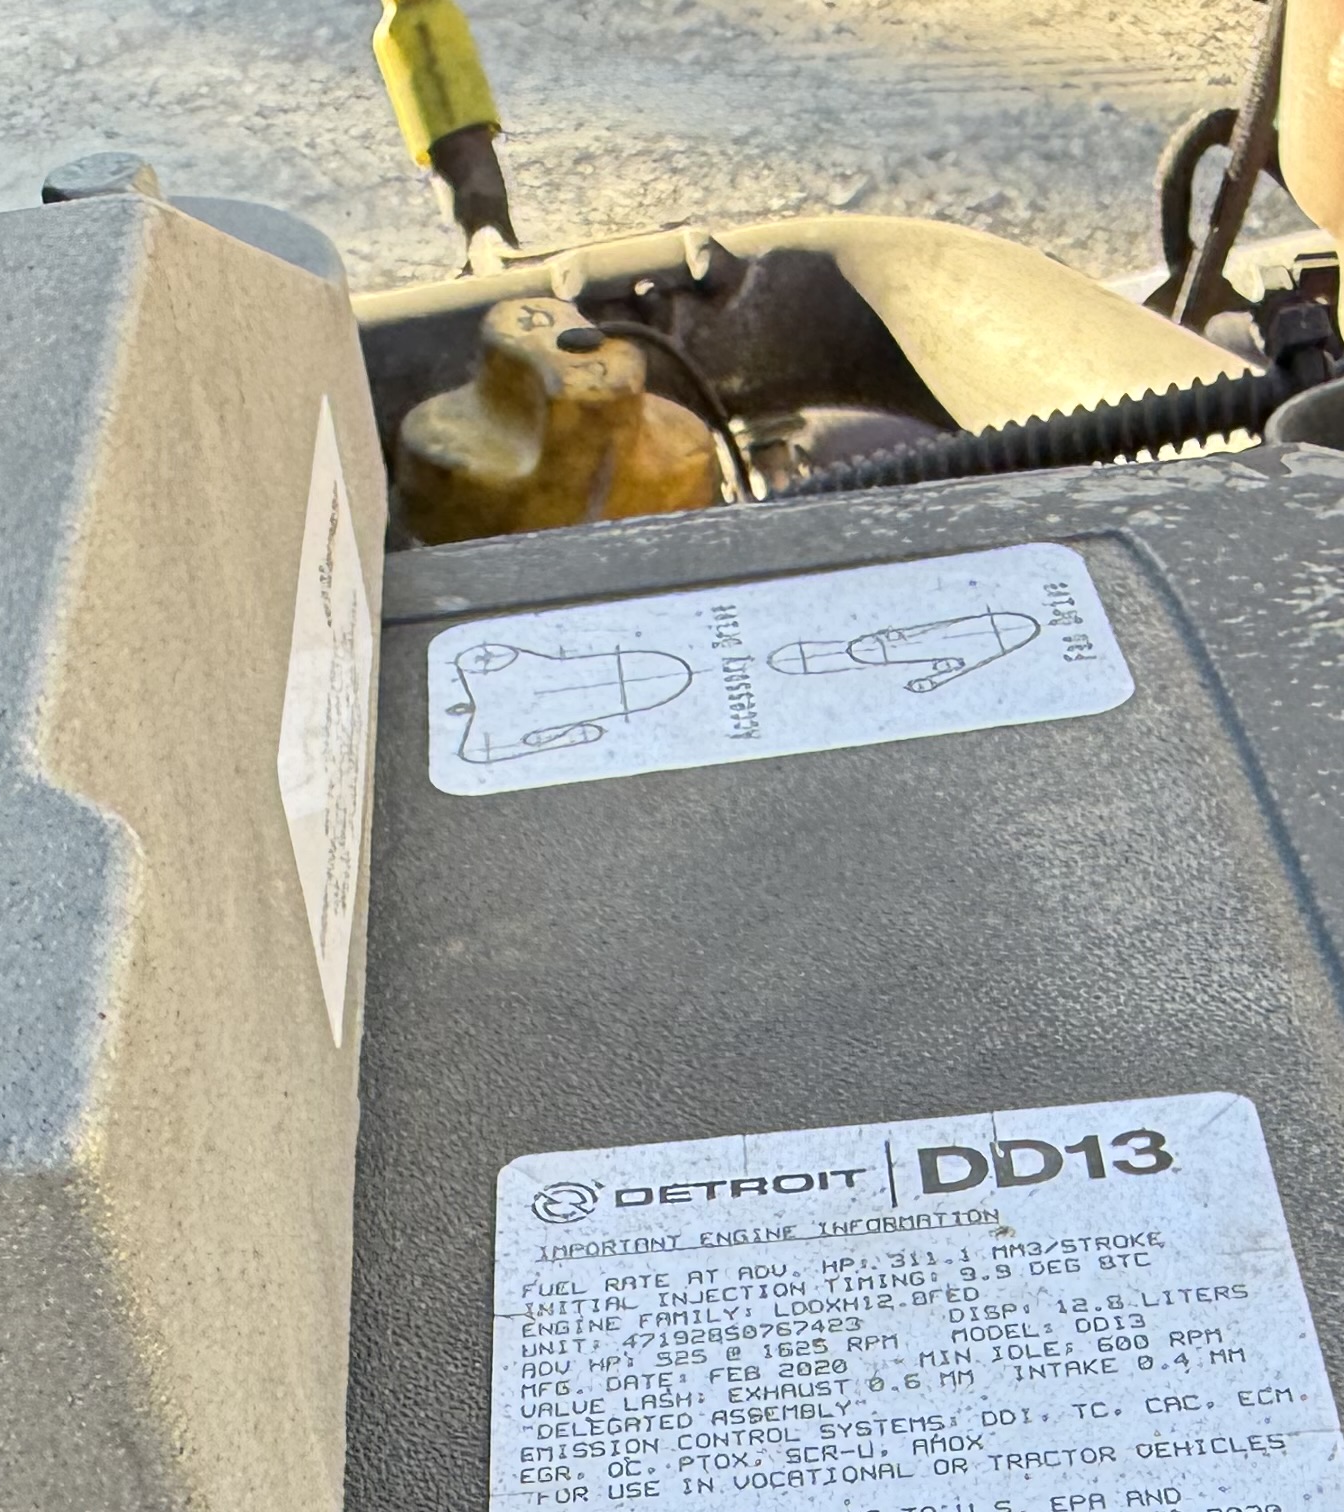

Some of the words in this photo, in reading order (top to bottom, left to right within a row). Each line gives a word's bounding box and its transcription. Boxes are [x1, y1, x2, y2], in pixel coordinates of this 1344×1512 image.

[613, 1167, 868, 1208] DETROIT
[917, 1128, 1175, 1196] DD13
[541, 1234, 684, 1261] IMPORTANT
[701, 1224, 799, 1247] ENGINE
[818, 1206, 999, 1236] INFORMATION
[521, 1279, 585, 1300] FUEL
[604, 1272, 669, 1293] RATE
[687, 1268, 719, 1286] AT
[992, 1230, 1166, 1260] MM3/STROKE
[523, 1294, 636, 1318] INITIAL
[657, 1280, 805, 1307] INJECTION
[960, 1263, 1012, 1281] 9.9
[1029, 1257, 1082, 1275] DEG
[1056, 1294, 1124, 1313] 12.8
[1142, 1283, 1249, 1306] LITERS
[521, 1316, 620, 1338] ENGINE
[846, 1332, 898, 1351] RPM
[1074, 1312, 1146, 1333] DD13
[521, 1379, 583, 1399] MFG.
[709, 1365, 760, 1384] FEB
[778, 1358, 847, 1378] 2020
[918, 1348, 971, 1367] MIN
[1096, 1333, 1150, 1352] 600
[1168, 1327, 1223, 1347] RPM
[728, 1378, 849, 1403] EXHAUST
[868, 1373, 920, 1392] 0.6
[939, 1368, 974, 1387] MM
[1012, 1357, 1118, 1381] INTAKE
[1136, 1351, 1191, 1371] 0.4
[1208, 1347, 1246, 1365] MM
[520, 1436, 658, 1463] EMISSION
[677, 1425, 800, 1451] CONTROL
[910, 1433, 983, 1455] AMOX
[608, 1480, 660, 1500] USE
[682, 1476, 713, 1494] IN
[733, 1461, 912, 1490] VOCATIONAL
[931, 1457, 967, 1475] OR
[986, 1446, 1115, 1471] TRACTOR
[1125, 1487, 1182, 1508] AND
